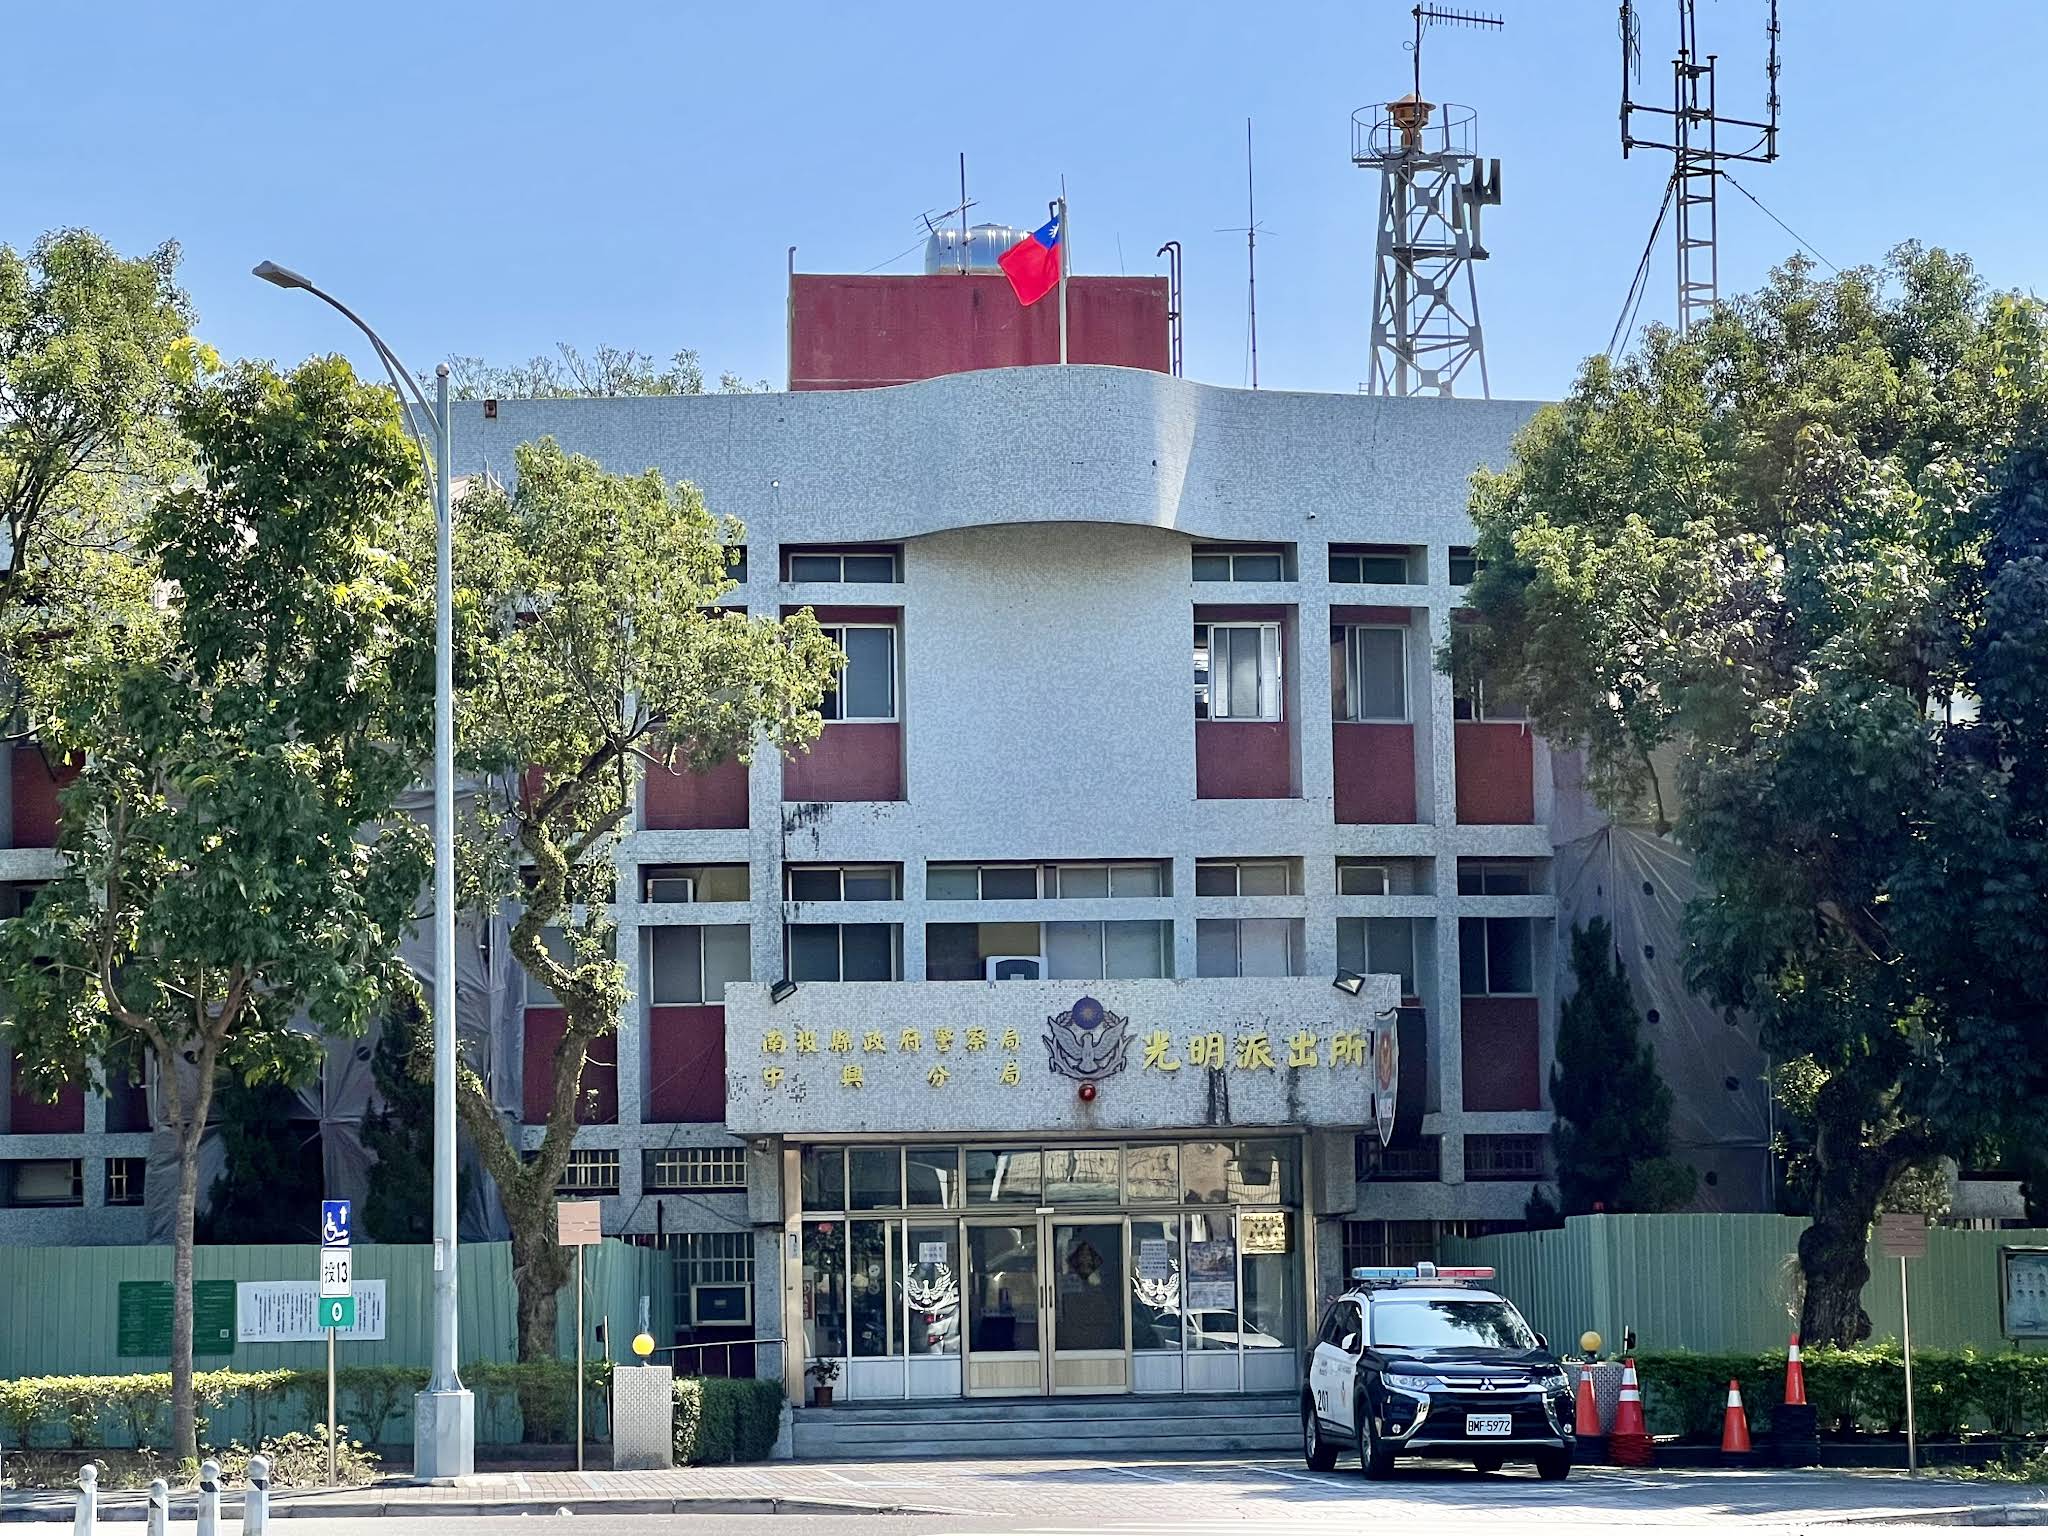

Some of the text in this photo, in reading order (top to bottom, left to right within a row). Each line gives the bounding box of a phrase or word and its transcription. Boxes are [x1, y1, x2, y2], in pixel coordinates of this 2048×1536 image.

[762, 1027, 1021, 1053] 南投縣政府警察局
[1142, 1030, 1367, 1072] 光明派出所
[763, 1063, 1021, 1088] 中興分局
[324, 1261, 348, 1283] 投13
[331, 1302, 343, 1322] 0
